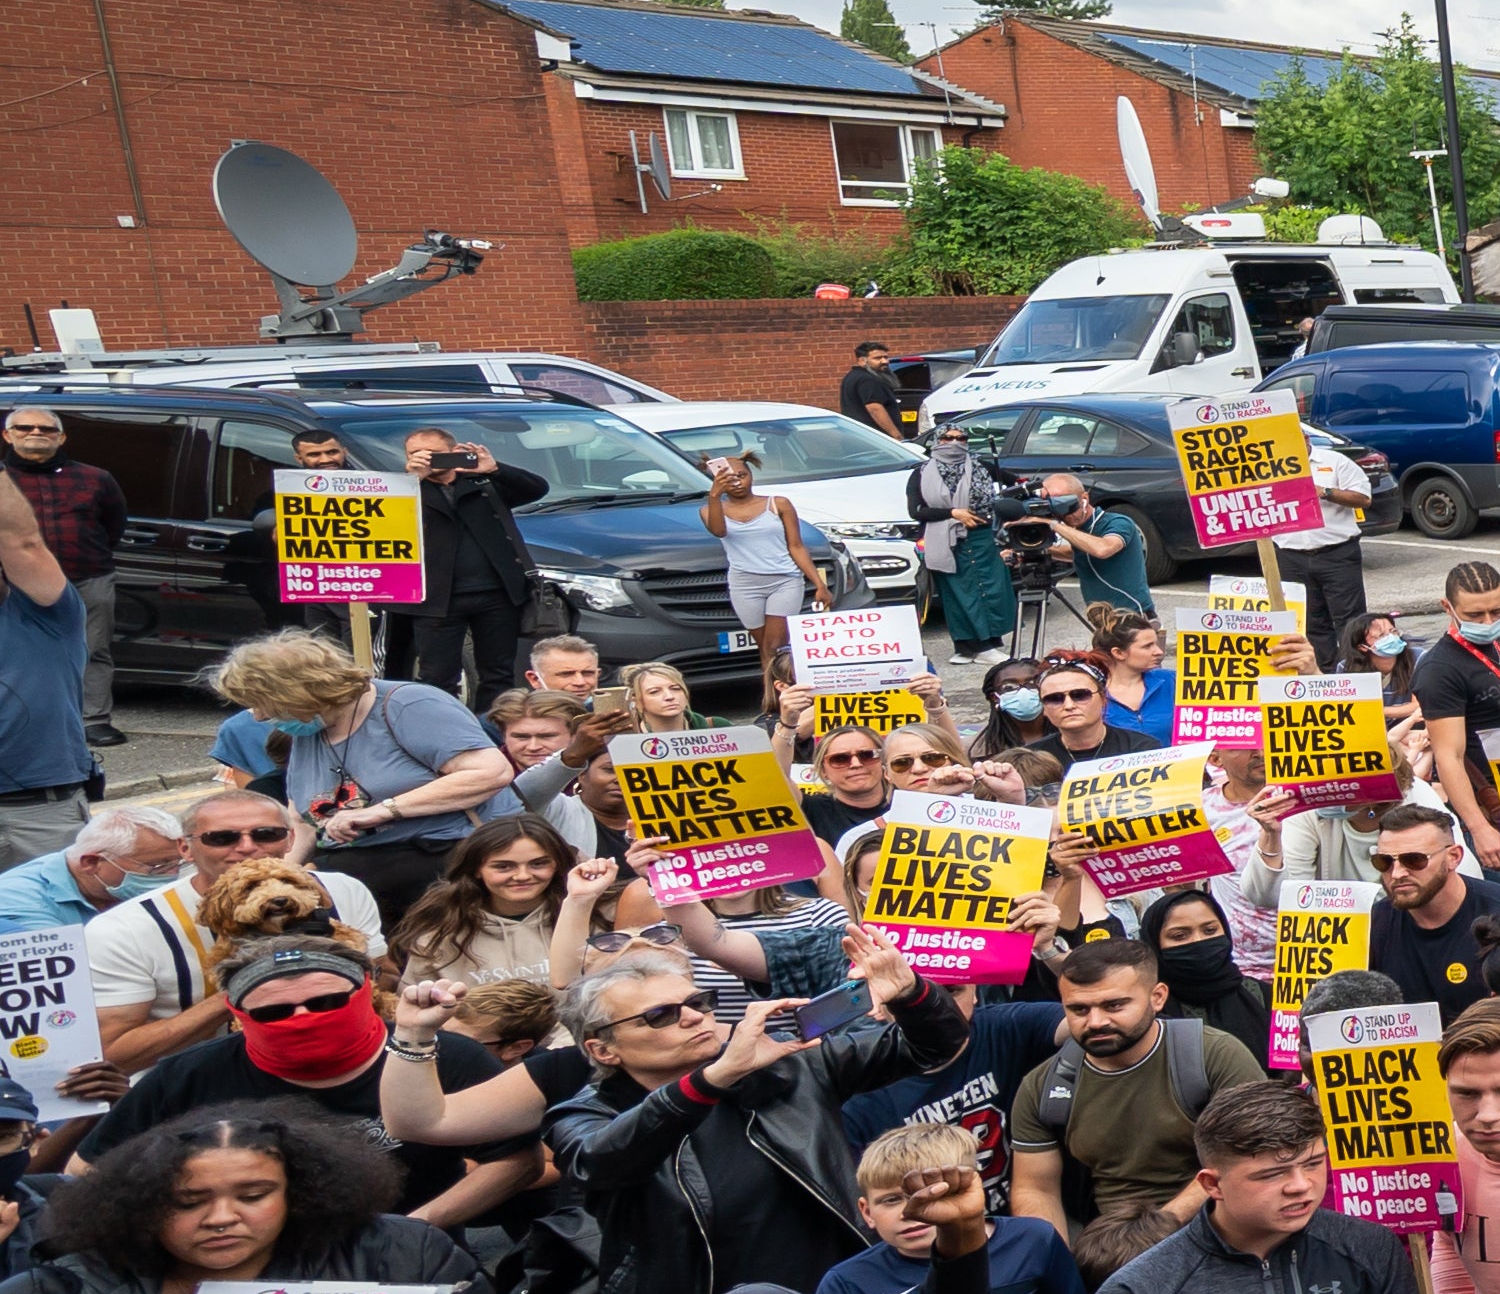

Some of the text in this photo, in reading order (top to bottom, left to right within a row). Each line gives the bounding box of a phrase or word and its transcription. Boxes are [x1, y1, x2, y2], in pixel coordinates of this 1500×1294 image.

[987, 380, 1050, 391] NEWS
[1220, 399, 1264, 412] STAND UP
[1237, 407, 1271, 418] RACISM
[1182, 425, 1248, 450] STOP
[1187, 440, 1275, 471] RACIST
[1195, 456, 1302, 490] ATTACKS
[1199, 487, 1275, 516] UNITE
[1206, 501, 1299, 535] & FIGHT
[801, 613, 882, 628] STAND
[804, 628, 876, 642] UP TO
[806, 643, 901, 659] RACISM
